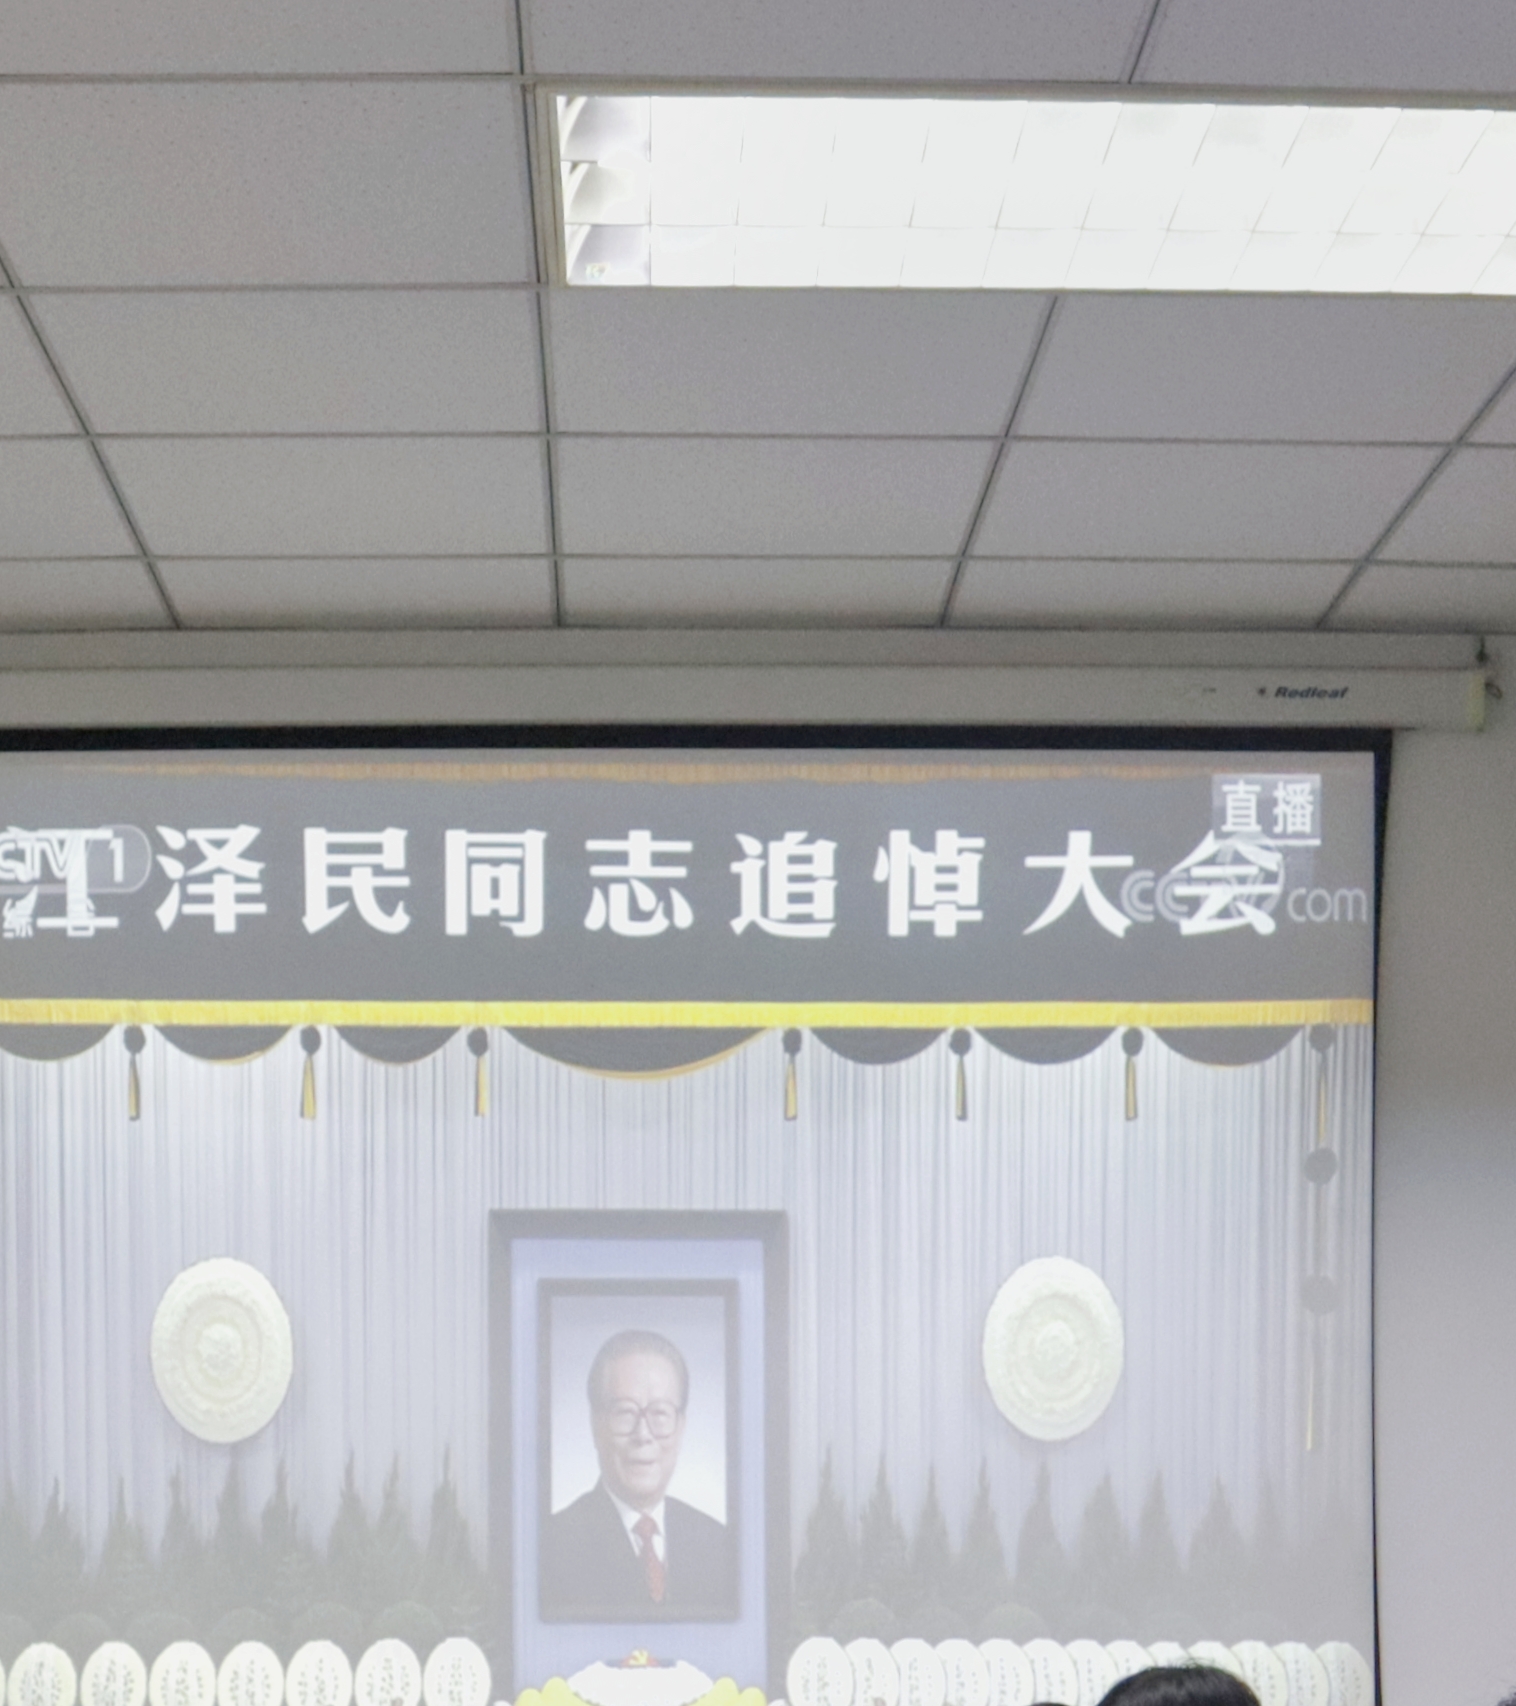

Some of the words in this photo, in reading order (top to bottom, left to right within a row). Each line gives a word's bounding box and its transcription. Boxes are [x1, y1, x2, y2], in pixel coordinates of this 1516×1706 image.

[1221, 779, 1314, 834] 直播
[3, 823, 1283, 936] 江泽民同志追悼大会
